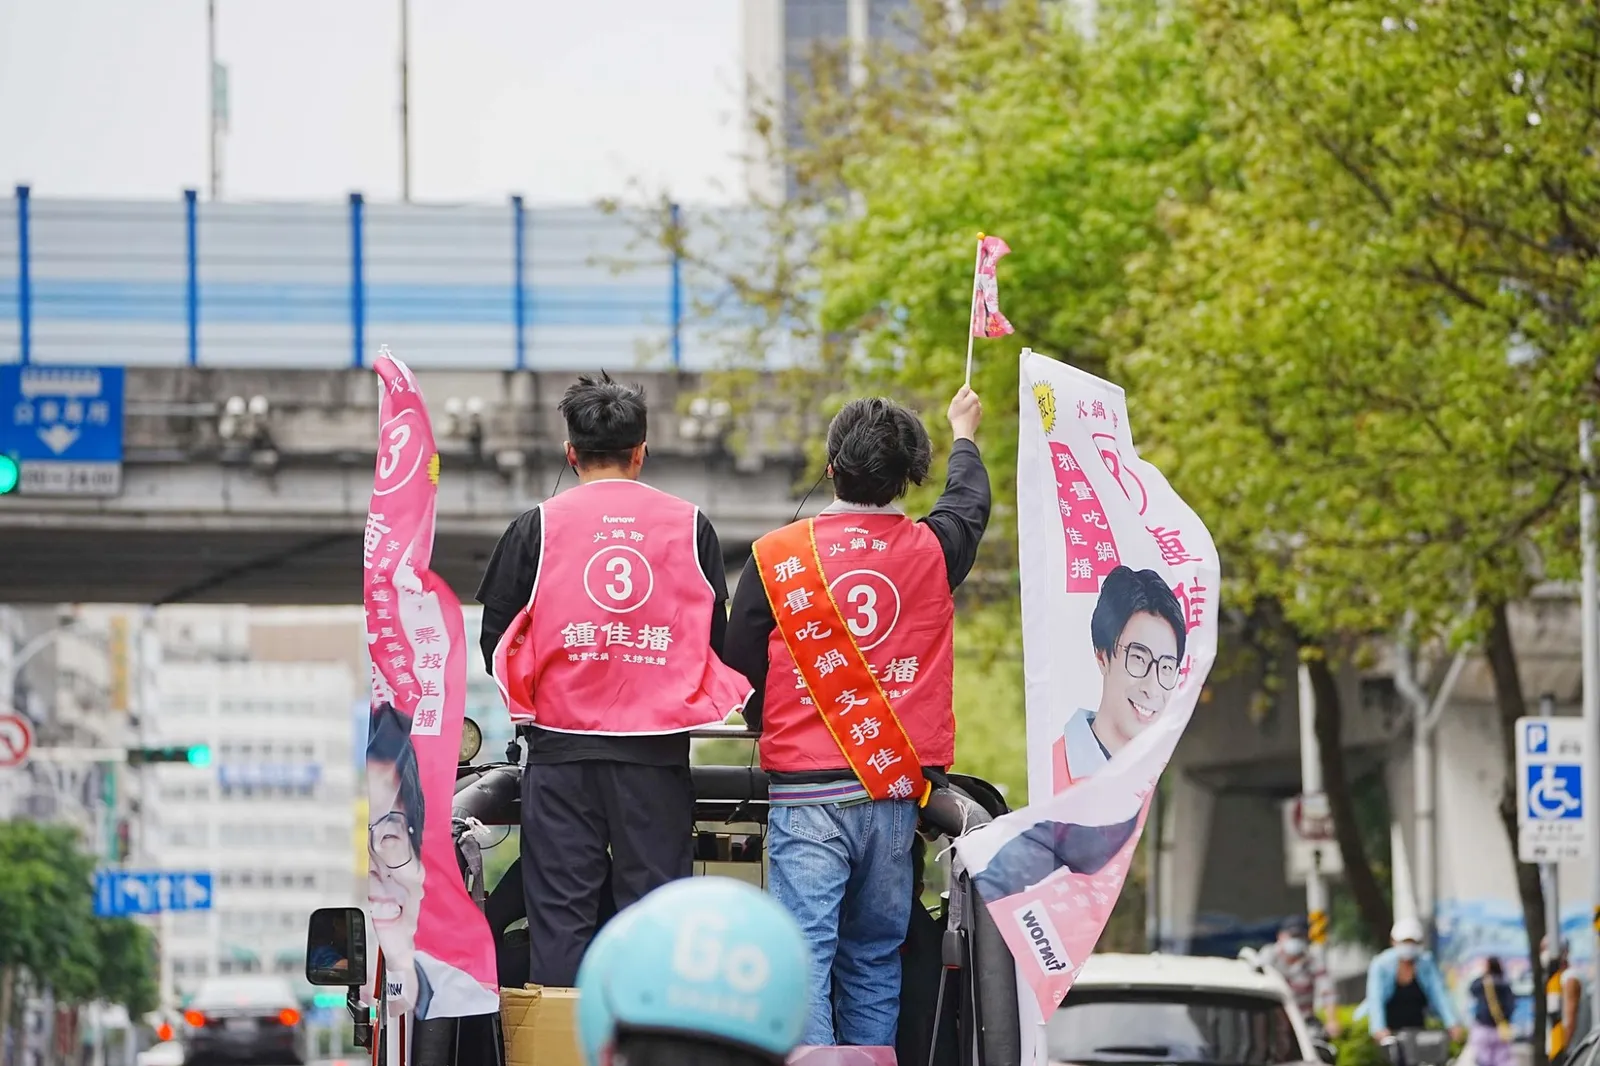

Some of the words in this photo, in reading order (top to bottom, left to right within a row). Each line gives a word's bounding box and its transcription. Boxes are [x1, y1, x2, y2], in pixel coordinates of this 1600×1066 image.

[378, 423, 411, 481] 3
[1056, 452, 1118, 563] 雅量吃鍋
[1056, 480, 1094, 579] 持佳播
[605, 556, 633, 601] 3
[560, 620, 674, 652] 鍾佳播
[846, 584, 878, 637] 3
